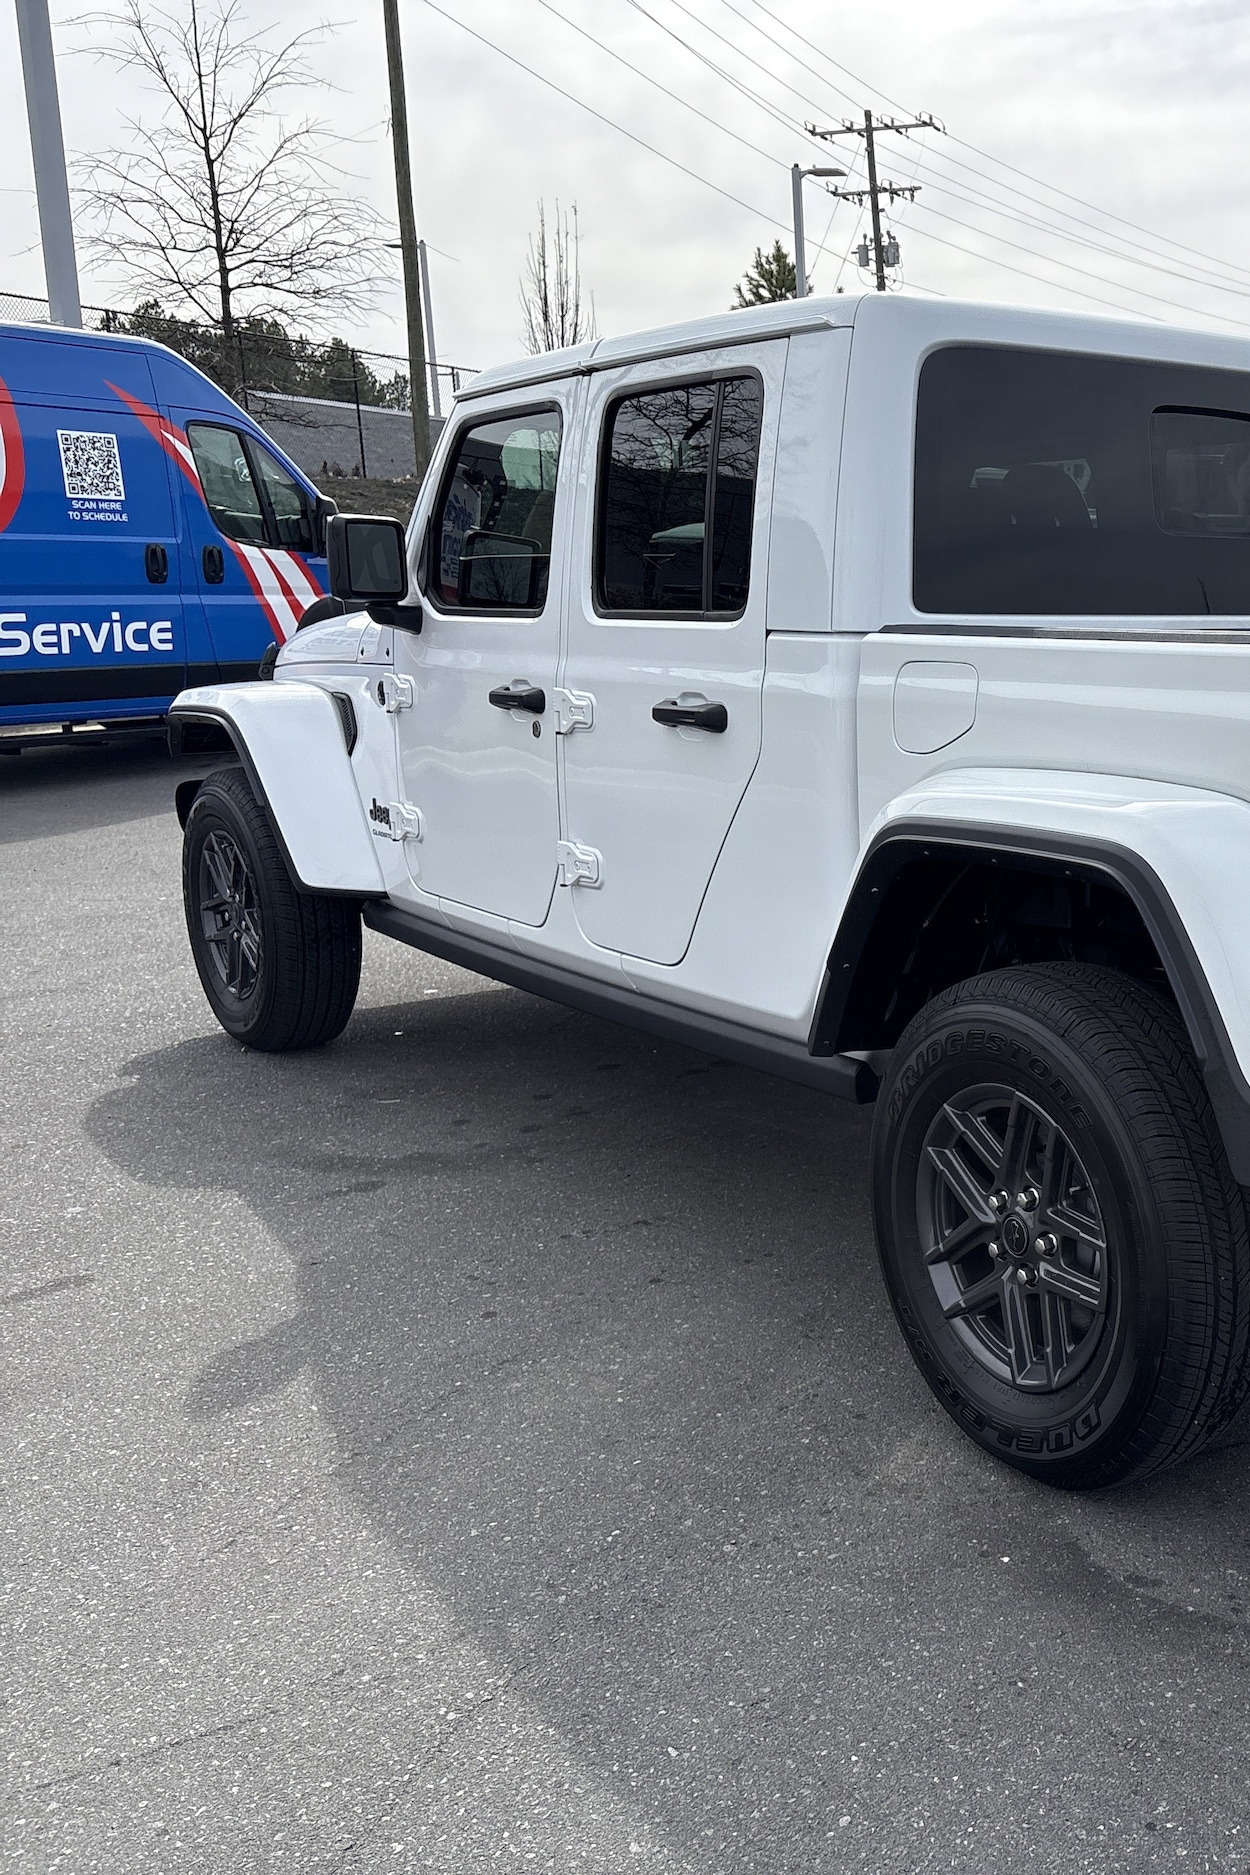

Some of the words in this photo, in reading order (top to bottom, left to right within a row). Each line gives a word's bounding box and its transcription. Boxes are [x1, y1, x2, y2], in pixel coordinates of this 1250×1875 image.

[67, 510, 80, 520] TO
[82, 511, 128, 522] SCHEDULE
[72, 500, 97, 510] SCAN
[98, 501, 122, 511] HERE
[0, 611, 174, 656] Service
[888, 1029, 1094, 1128] BRIDGESTONE
[936, 1370, 1102, 1454] DUELER
